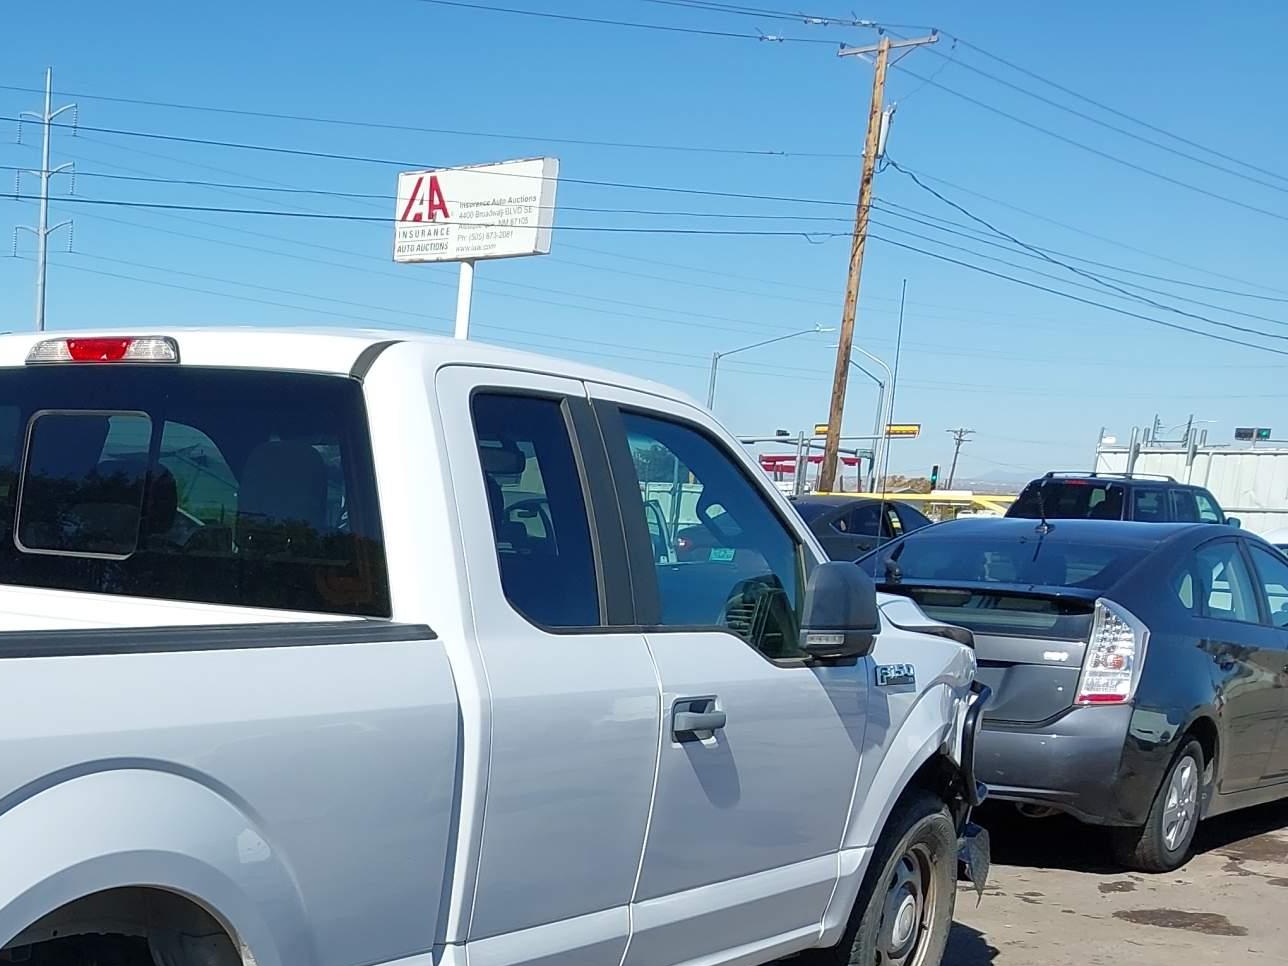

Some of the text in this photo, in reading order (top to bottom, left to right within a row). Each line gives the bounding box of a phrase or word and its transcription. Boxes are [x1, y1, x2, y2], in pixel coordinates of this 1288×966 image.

[508, 194, 537, 204] Auctions
[398, 227, 450, 239] INSURANCE
[397, 241, 449, 253] AUTO AUCTIONS
